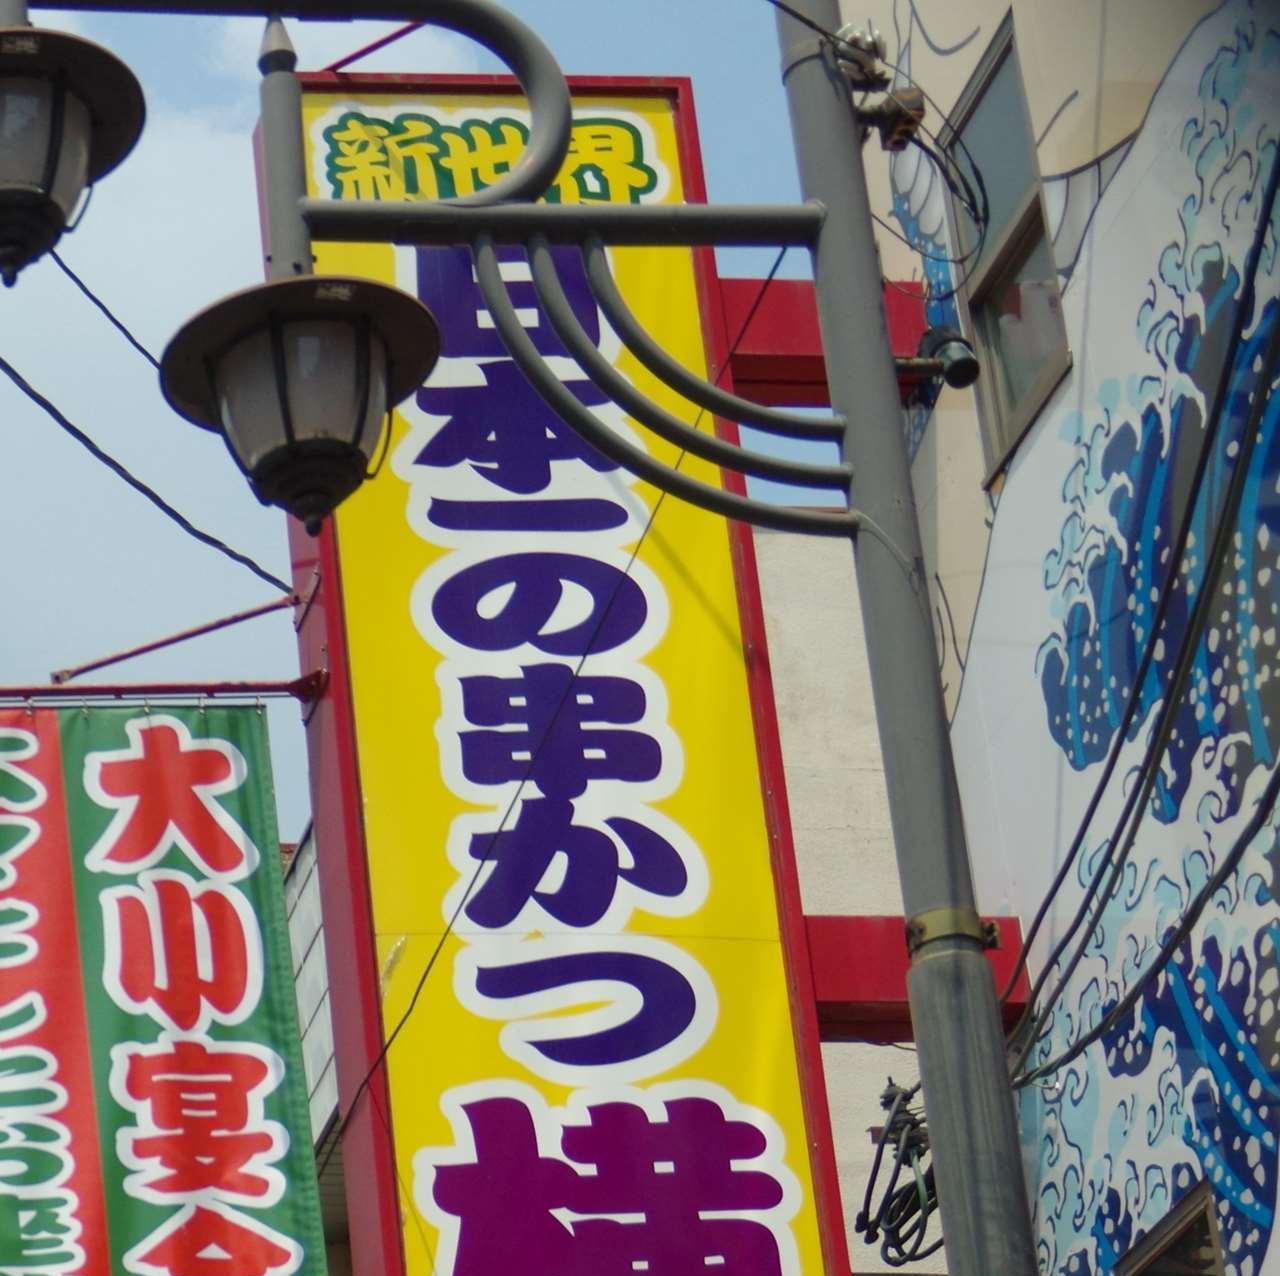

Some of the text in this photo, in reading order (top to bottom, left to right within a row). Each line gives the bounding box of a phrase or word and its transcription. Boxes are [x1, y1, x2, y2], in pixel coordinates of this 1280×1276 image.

[330, 116, 656, 206] 新世界
[412, 243, 696, 1068] 日本一の串かつ
